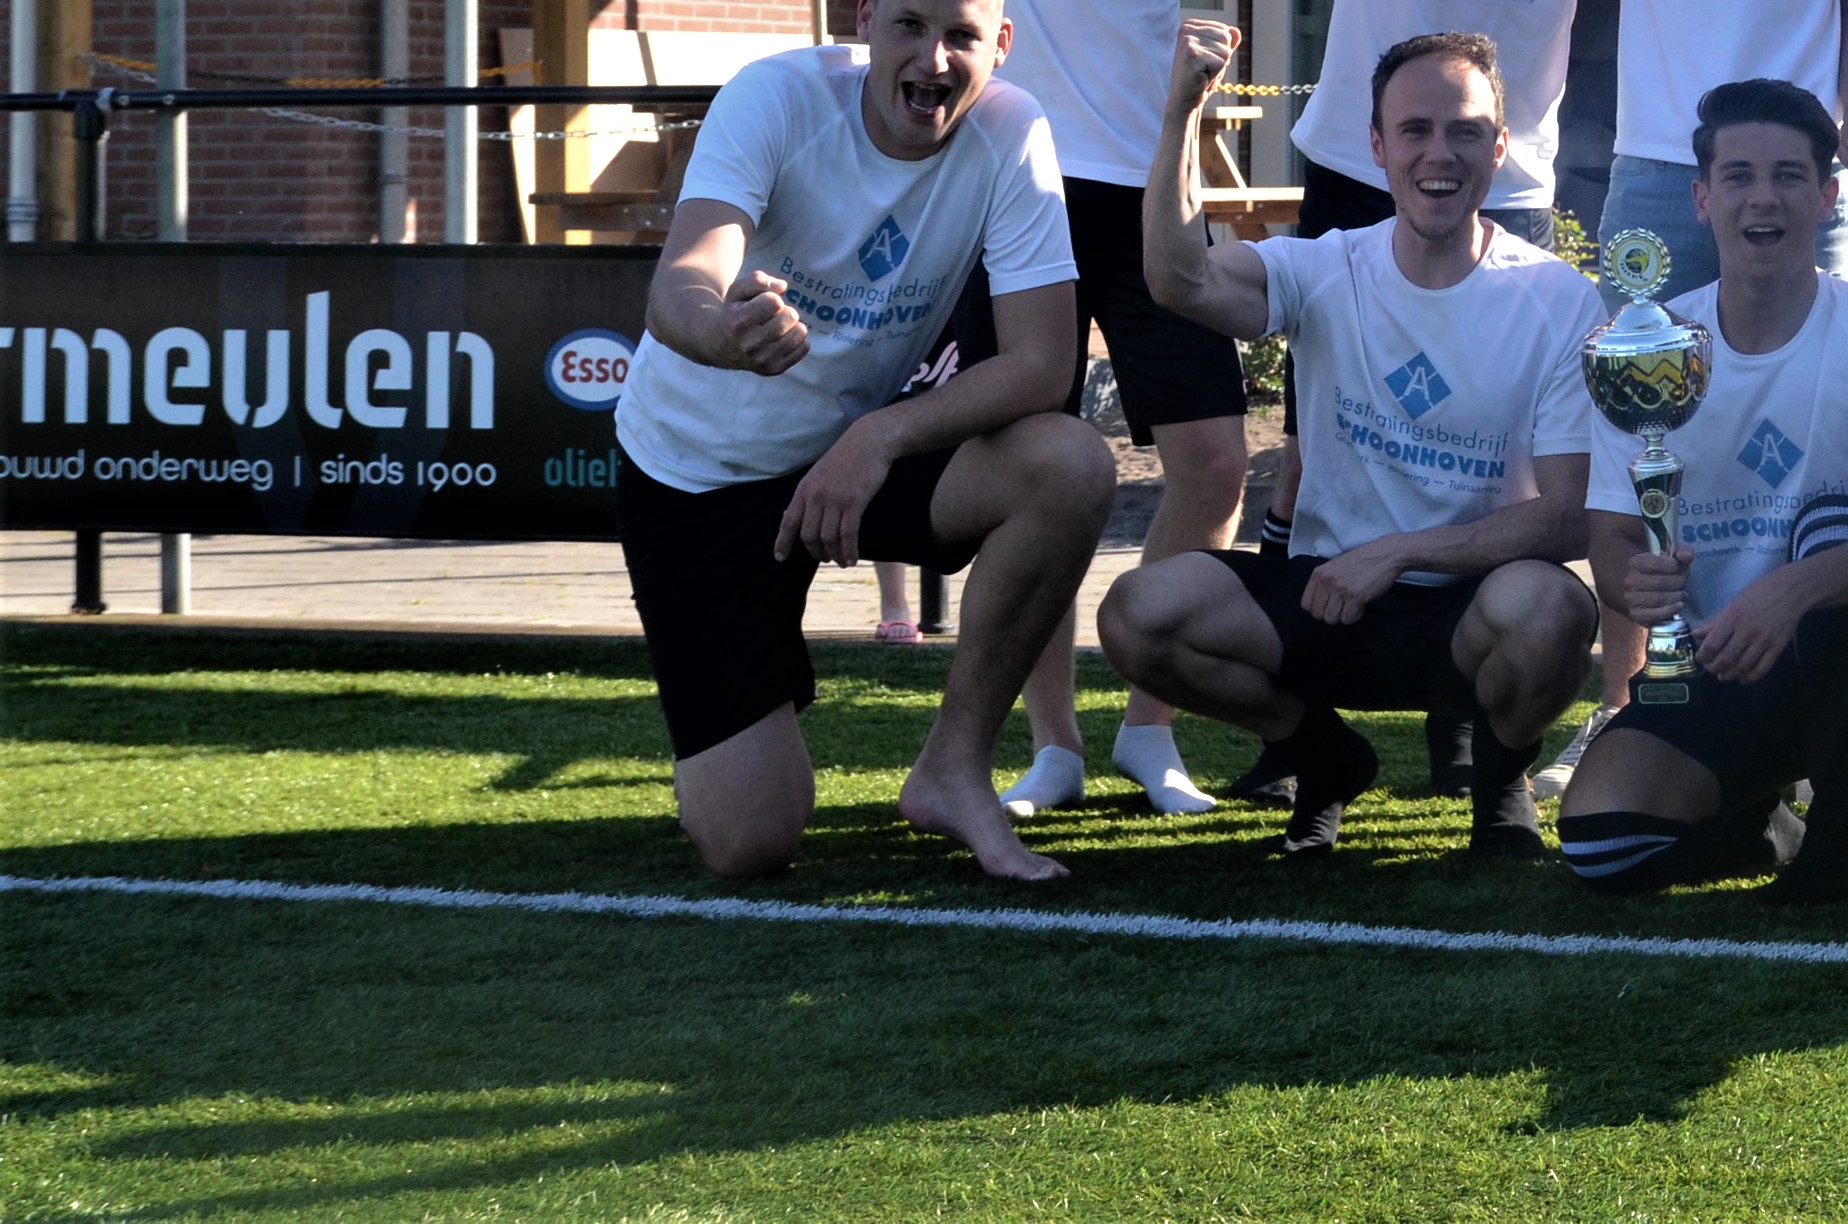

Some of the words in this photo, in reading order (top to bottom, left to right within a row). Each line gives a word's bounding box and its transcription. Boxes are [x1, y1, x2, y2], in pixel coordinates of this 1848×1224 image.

[562, 350, 629, 384] Esso
[94, 449, 274, 491] onderweg
[321, 454, 404, 486] sinds
